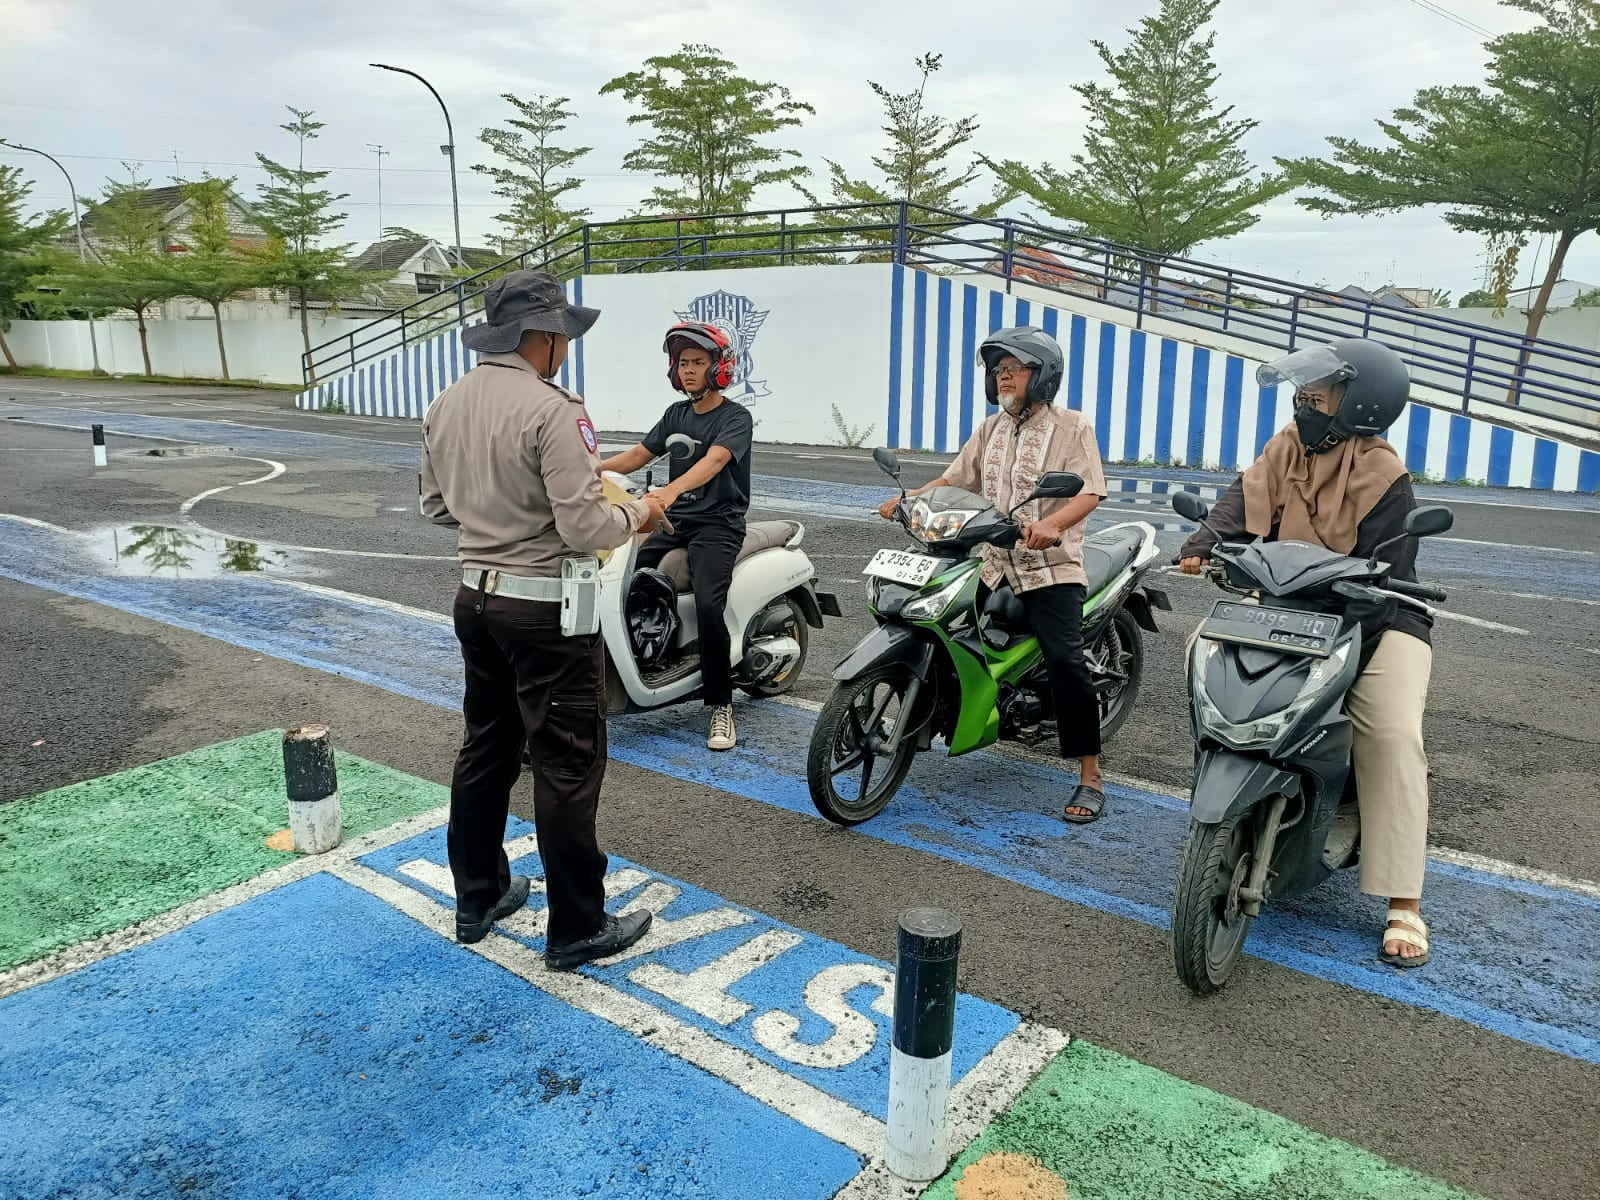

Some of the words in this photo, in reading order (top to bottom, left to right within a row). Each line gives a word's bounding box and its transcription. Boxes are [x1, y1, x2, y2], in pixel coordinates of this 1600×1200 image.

[875, 551, 885, 561] S
[887, 552, 914, 566] 2354
[1298, 729, 1328, 755] HONDA
